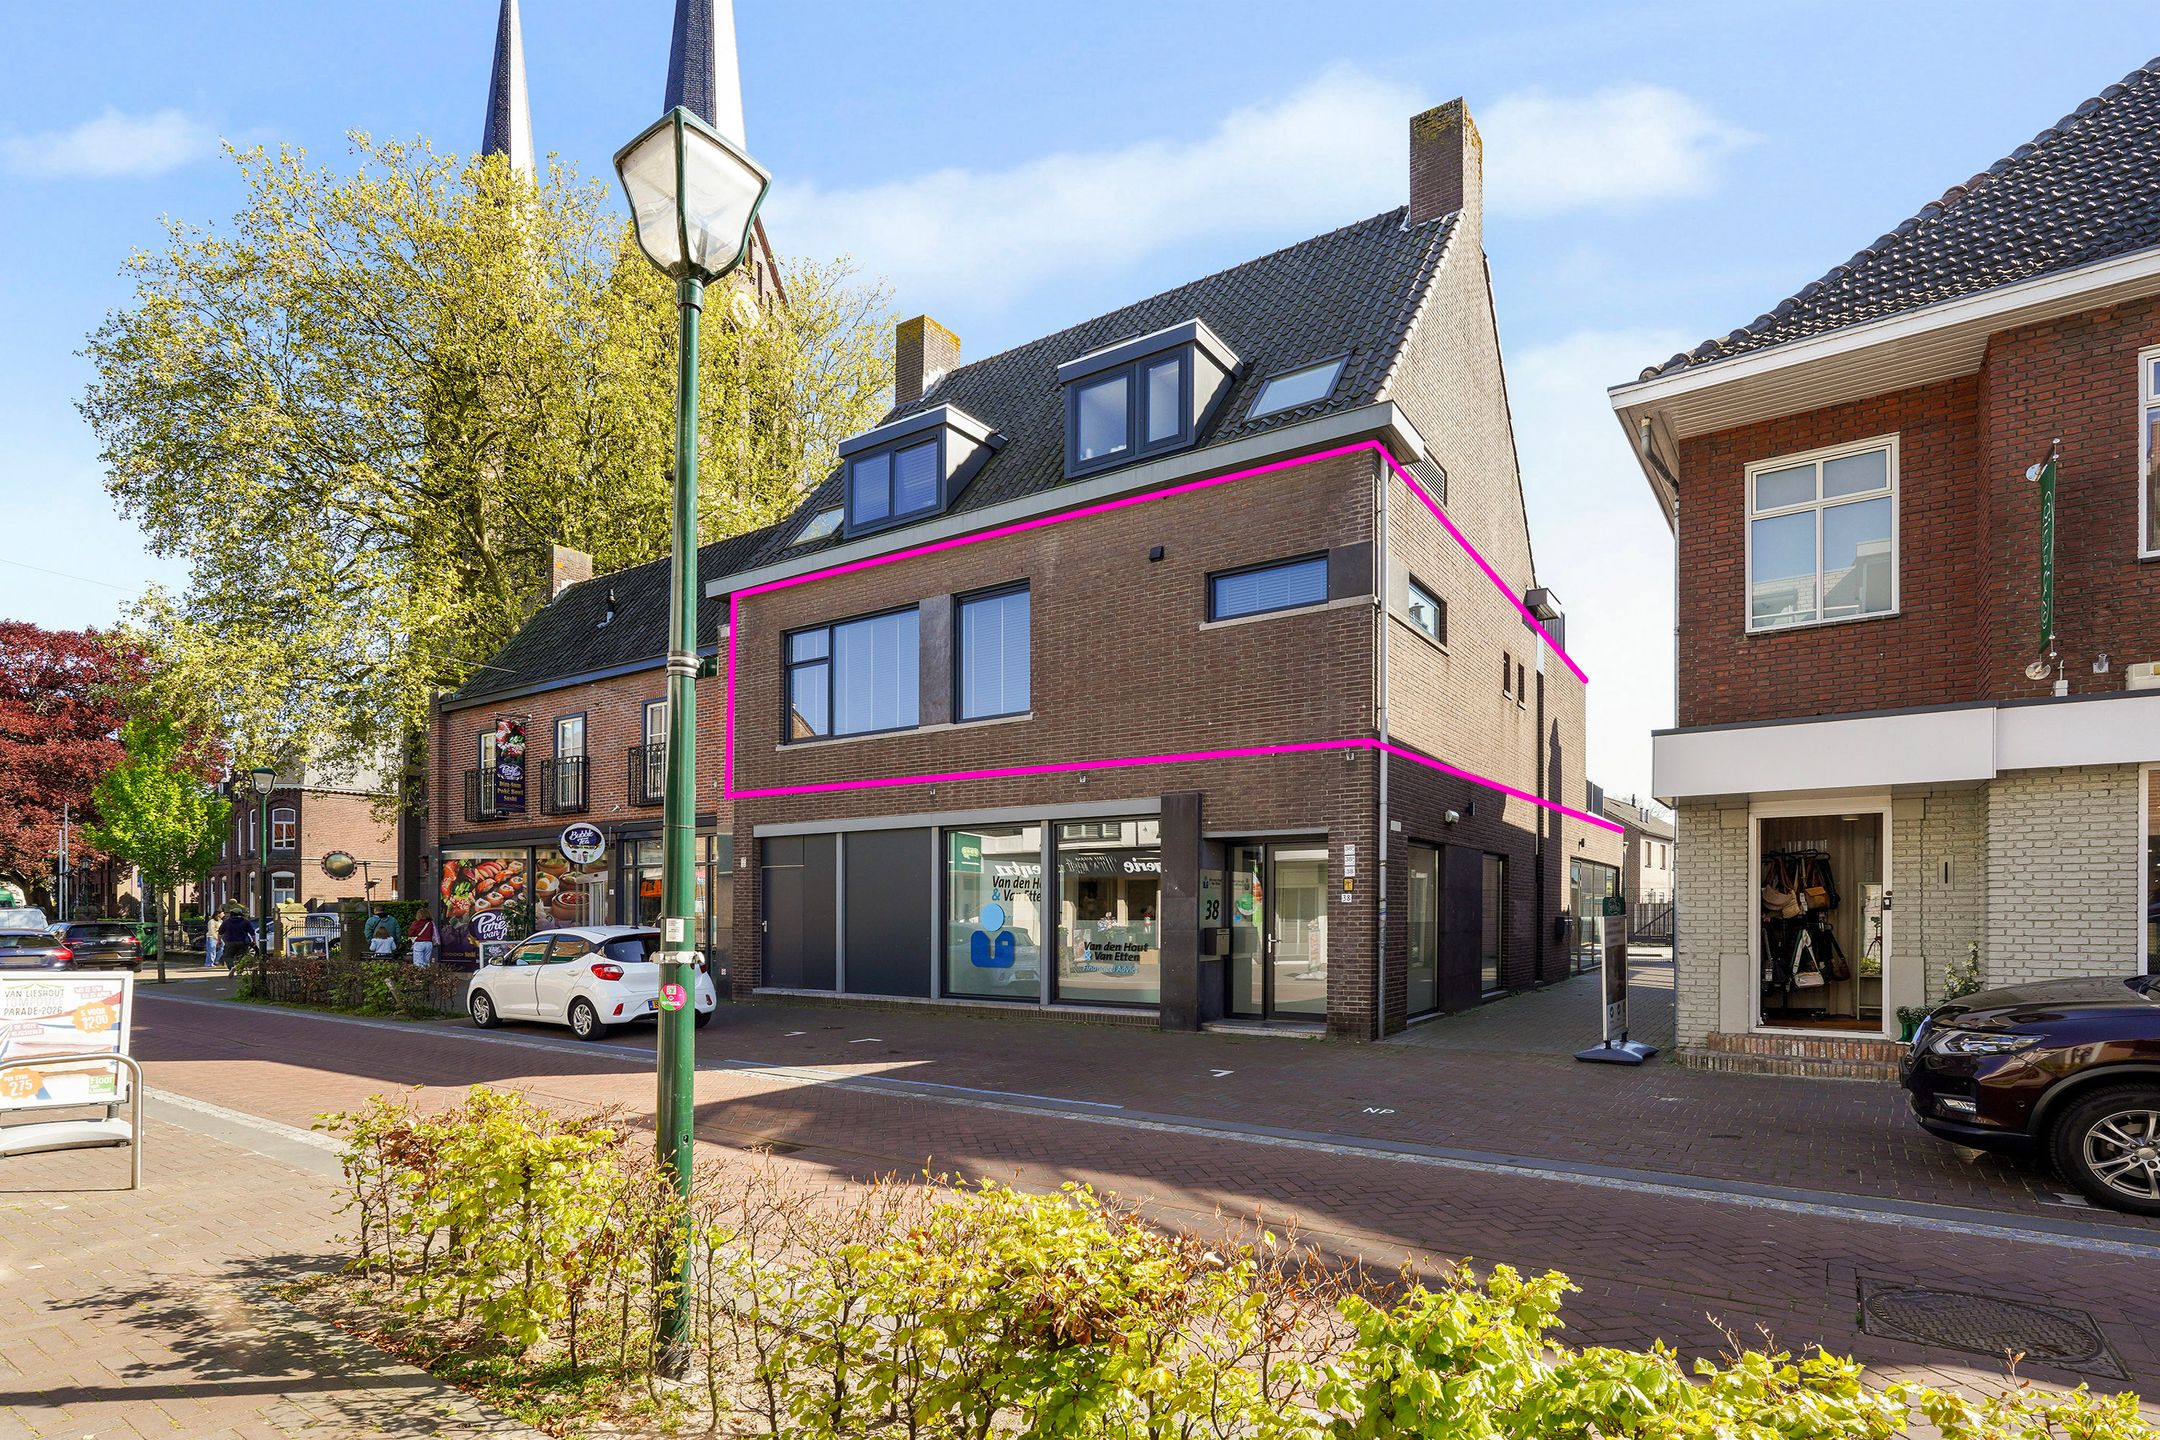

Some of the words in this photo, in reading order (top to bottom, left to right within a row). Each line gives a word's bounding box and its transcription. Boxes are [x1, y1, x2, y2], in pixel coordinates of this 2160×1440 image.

[569, 829, 594, 841] Bubble
[577, 837, 590, 846] Tea
[992, 875, 1011, 888] Van
[1013, 875, 1031, 889] den
[1032, 877, 1041, 889] H
[992, 888, 1001, 901] &
[1003, 889, 1022, 901] Va
[1343, 894, 1351, 902] 38
[1205, 899, 1220, 920] 38
[1084, 941, 1102, 951] Van
[1104, 941, 1122, 951] den
[1124, 942, 1149, 952] Hout
[1095, 951, 1113, 961] Van
[1114, 952, 1140, 962] Etten
[5, 989, 22, 998] VAN
[25, 989, 64, 997] LIESHOUT
